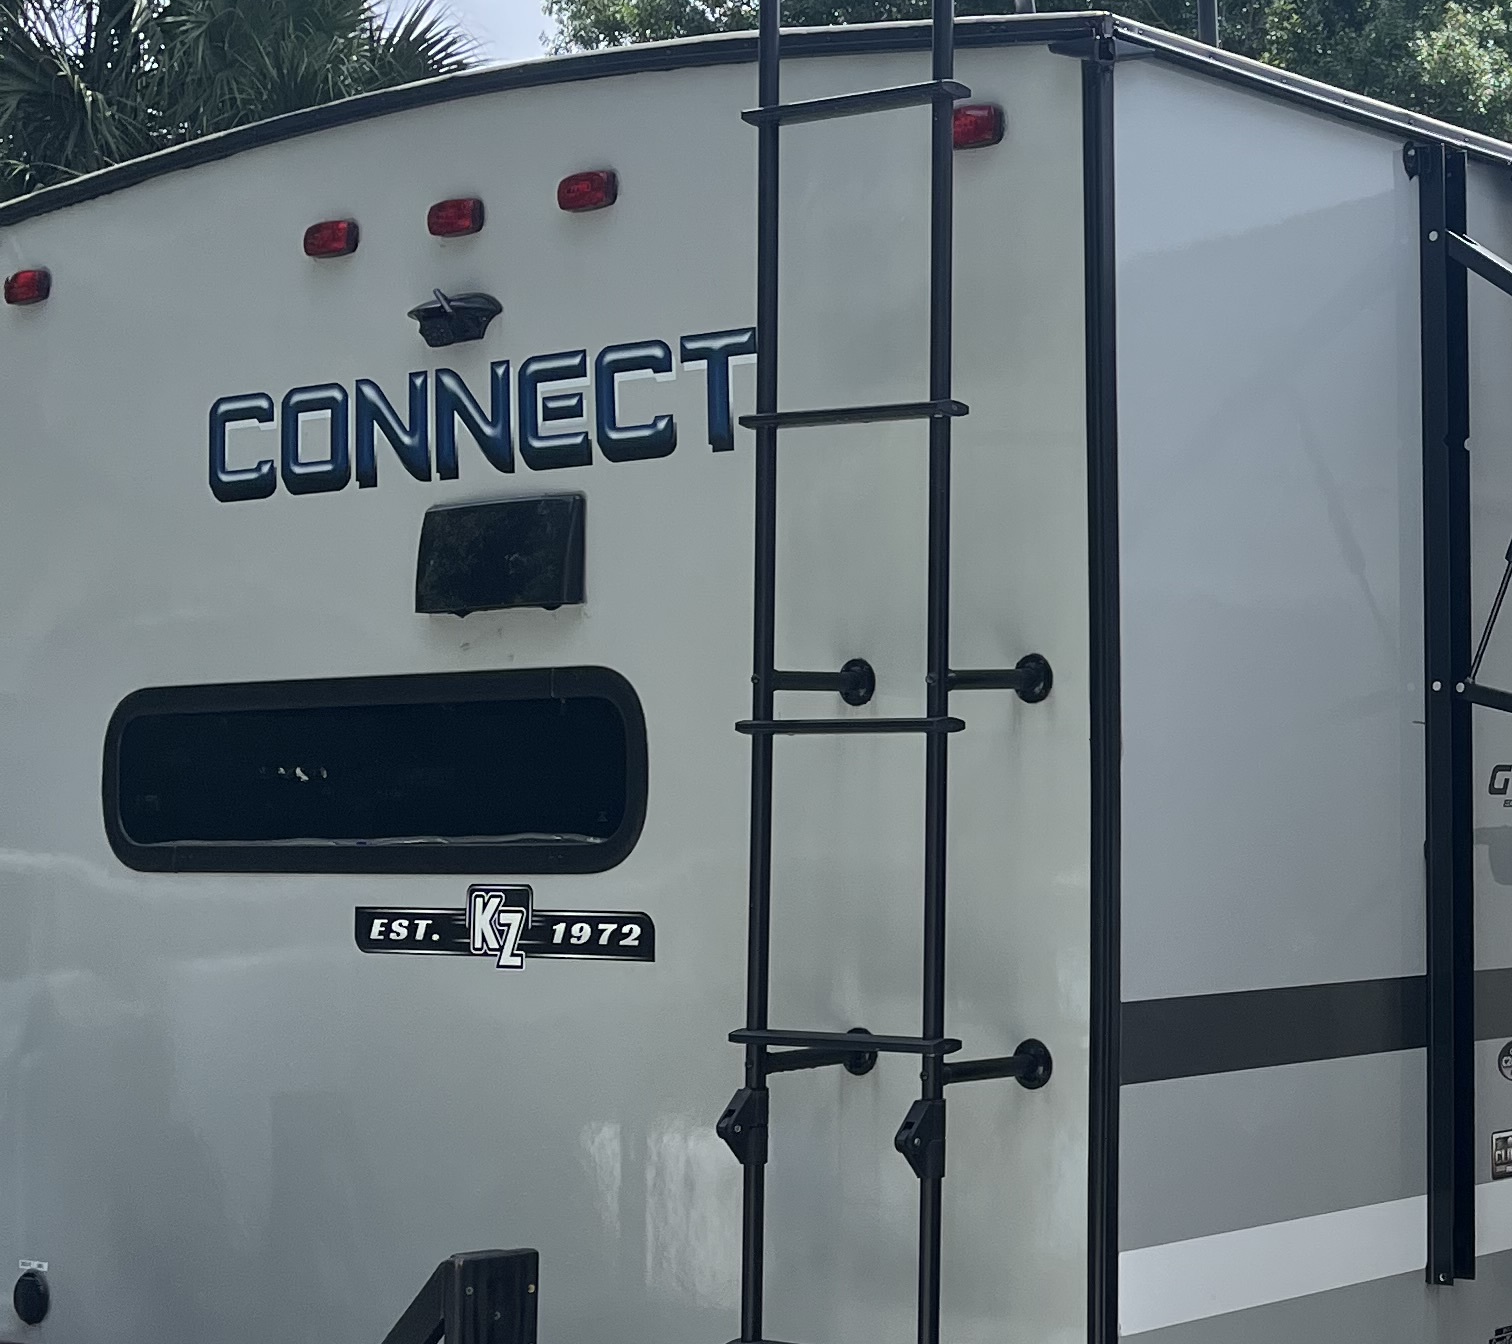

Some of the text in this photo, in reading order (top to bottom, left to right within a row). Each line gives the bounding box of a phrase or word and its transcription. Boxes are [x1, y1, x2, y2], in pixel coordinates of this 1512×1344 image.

[208, 327, 757, 503] CONNECT
[369, 893, 641, 969] EST. KZ 1972
